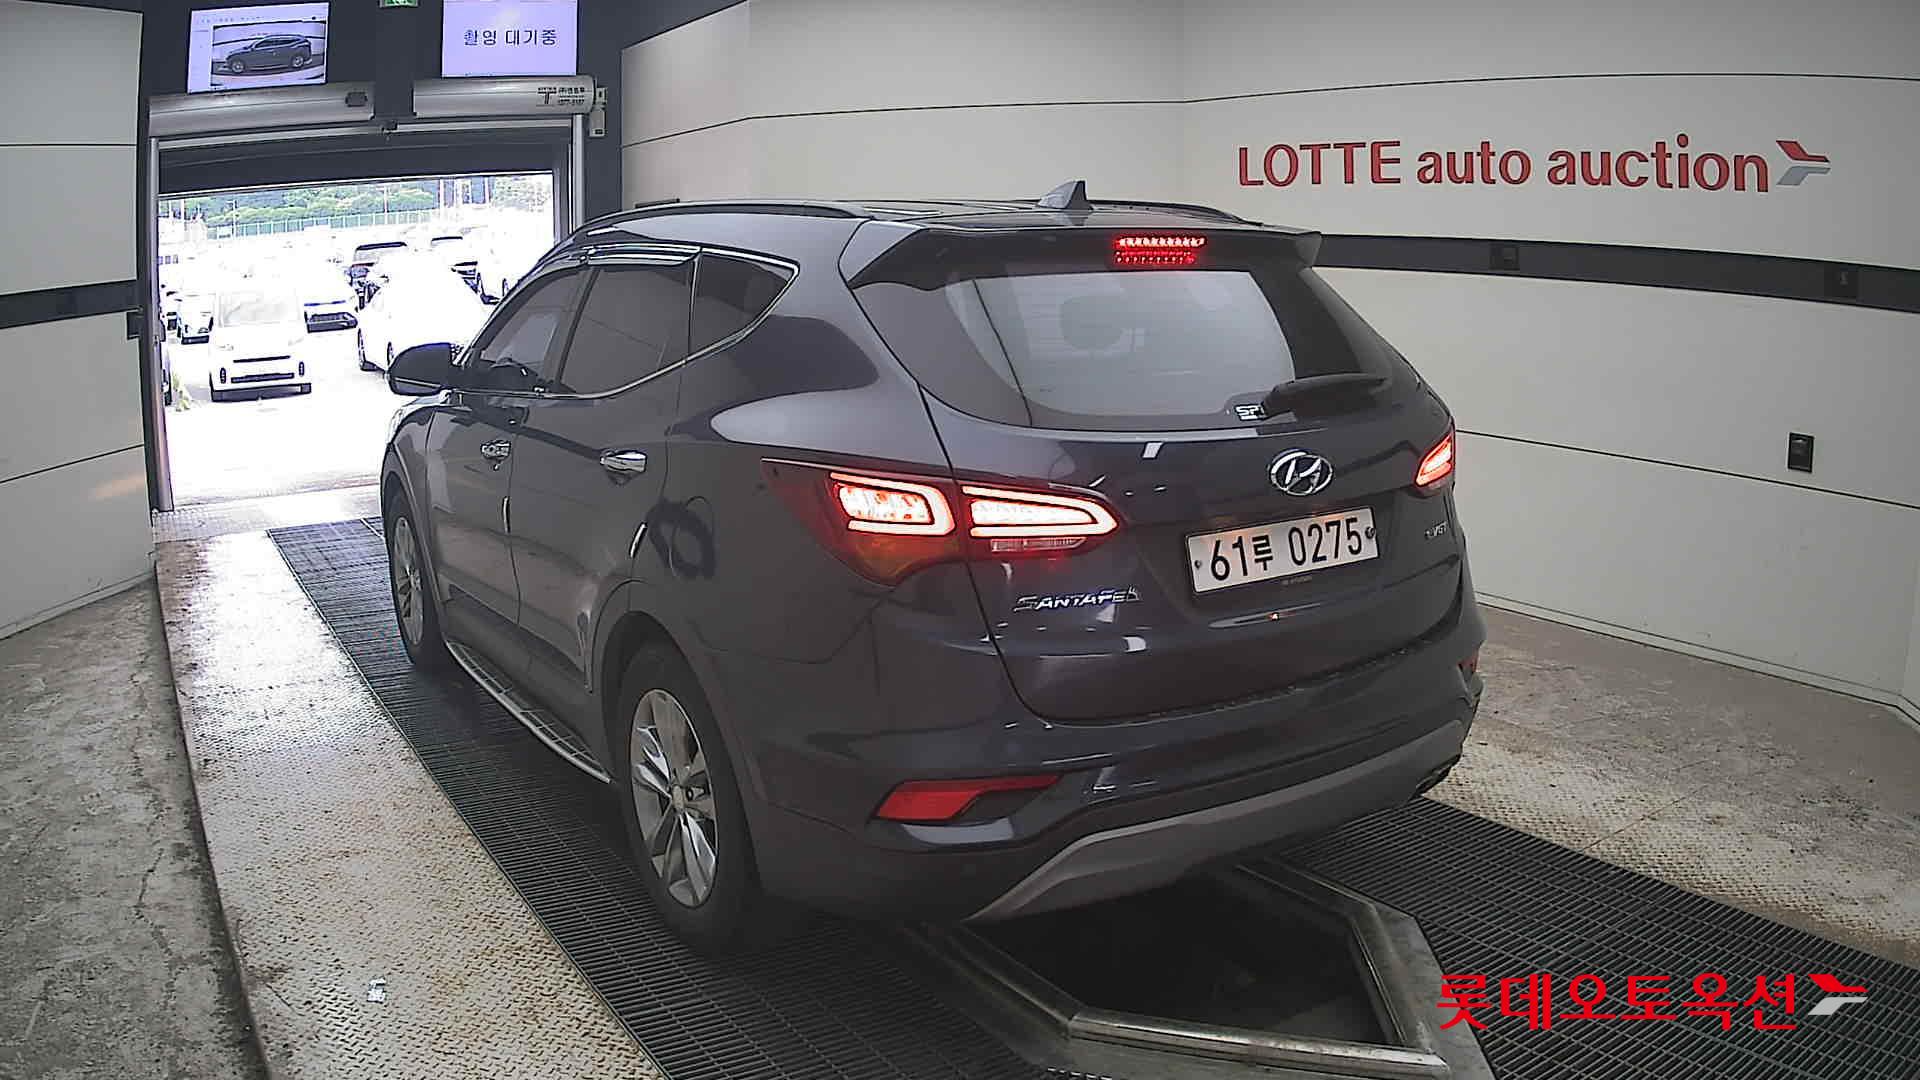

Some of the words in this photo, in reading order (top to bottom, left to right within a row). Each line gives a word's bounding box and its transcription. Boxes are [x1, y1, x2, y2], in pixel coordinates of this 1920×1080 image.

[505, 29, 556, 46] 대기중
[1239, 140, 1401, 187] LOTTE
[1417, 141, 1532, 185] auto
[1547, 133, 1769, 193] auction
[1210, 534, 1274, 581] 61루
[1288, 517, 1363, 567] 0275
